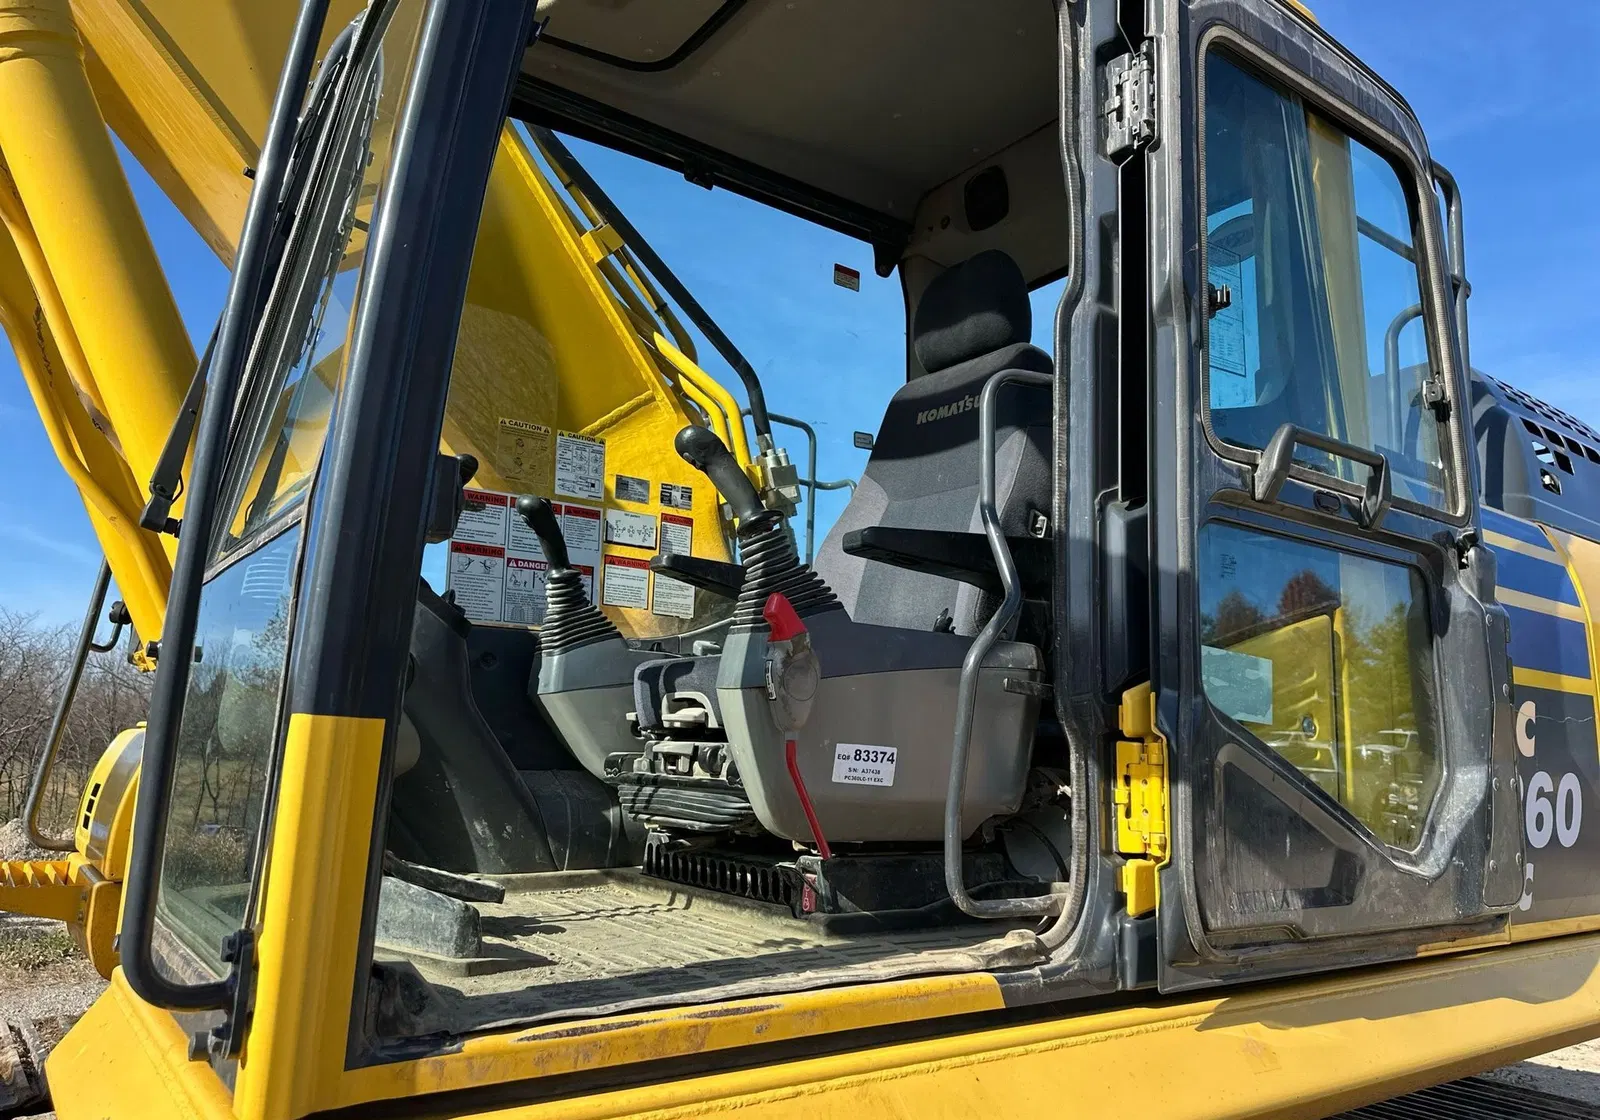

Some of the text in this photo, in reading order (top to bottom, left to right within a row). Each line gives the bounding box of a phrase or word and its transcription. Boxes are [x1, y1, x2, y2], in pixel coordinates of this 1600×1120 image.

[916, 395, 981, 425] KOMATSU
[508, 420, 542, 432] CAUTION
[567, 432, 596, 442] CAUTION
[467, 493, 505, 504] WARNING
[464, 546, 503, 556] WARNING
[616, 560, 648, 569] WARNING
[853, 749, 895, 764] 83374
[1519, 771, 1582, 848] 60
